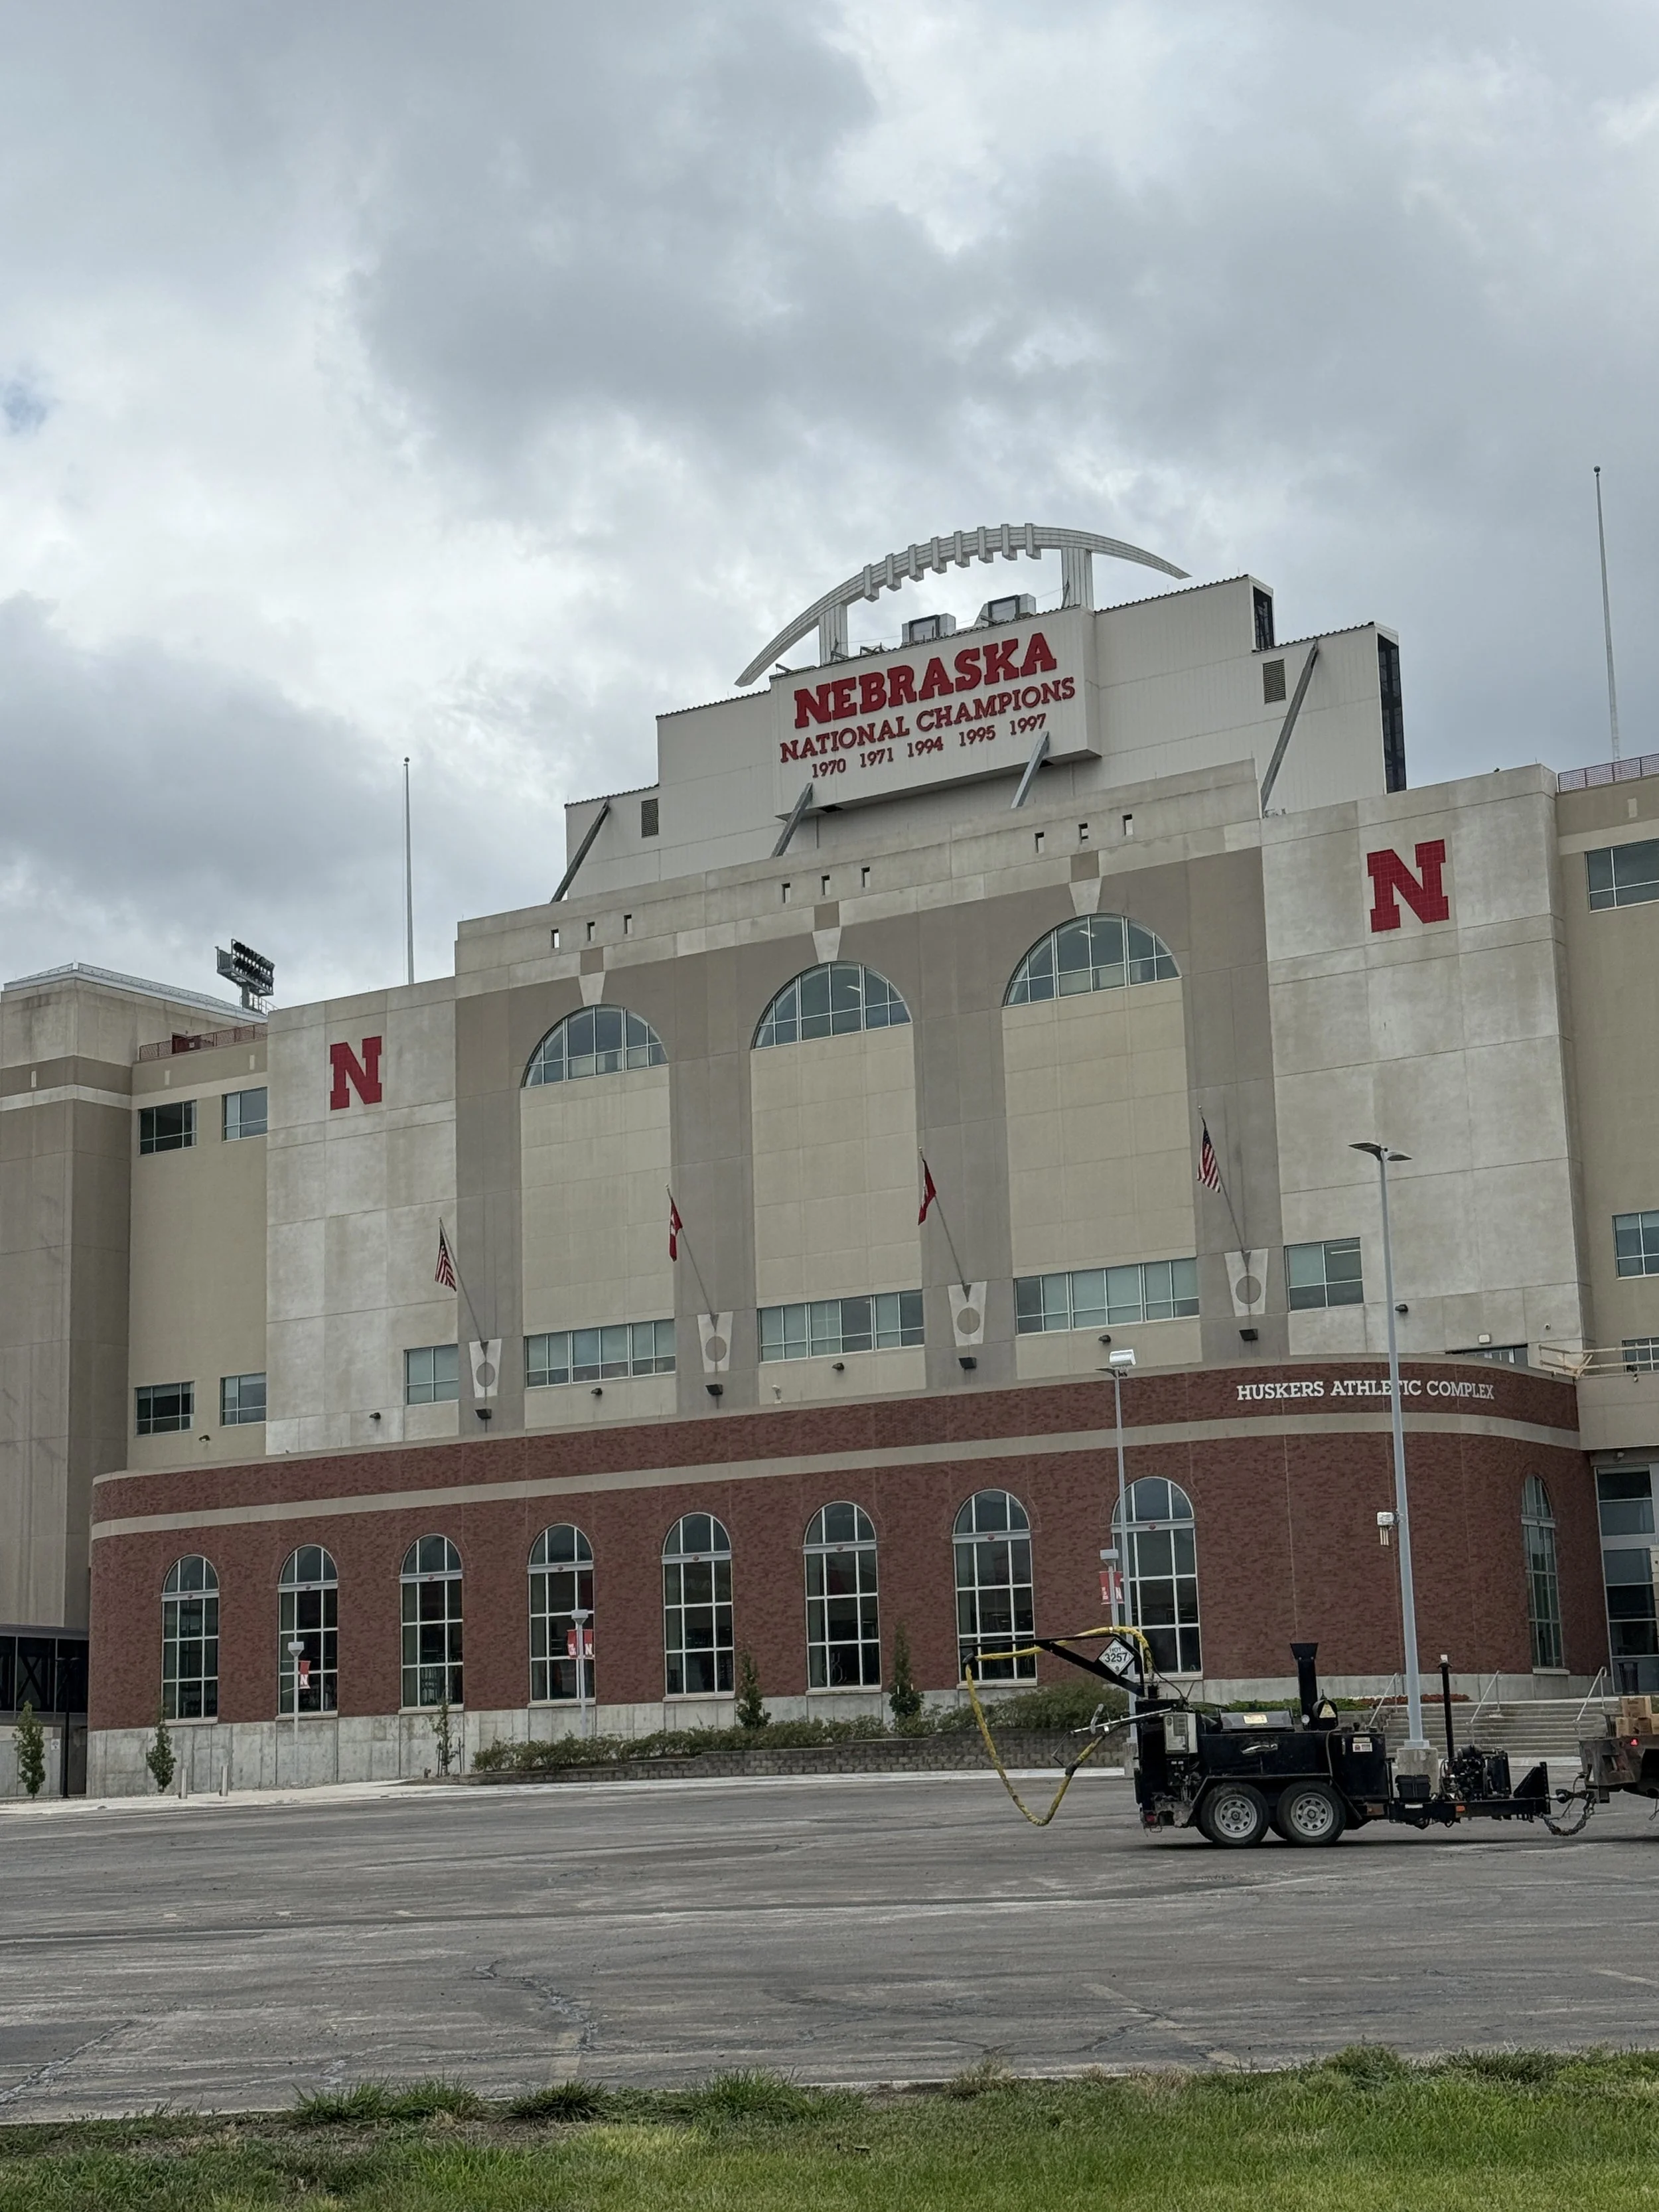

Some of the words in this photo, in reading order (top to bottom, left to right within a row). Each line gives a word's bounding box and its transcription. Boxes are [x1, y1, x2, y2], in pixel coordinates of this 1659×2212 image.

[794, 632, 1057, 729] NEBRASKA
[779, 715, 910, 763] NATIONAL
[916, 676, 1076, 732] CHAMPIONS
[812, 758, 847, 778] 1970
[859, 747, 895, 768] 1971
[907, 736, 944, 758] 1994
[959, 725, 996, 747] 1995
[1009, 713, 1046, 736] 1997
[1366, 838, 1450, 933] N
[329, 1035, 382, 1111] N
[1237, 1381, 1325, 1401] HUSKERS
[1427, 1380, 1495, 1400] COMPLEX
[300, 1674, 308, 1685] N
[585, 1643, 593, 1655] N
[1104, 1652, 1128, 1662] 3257
